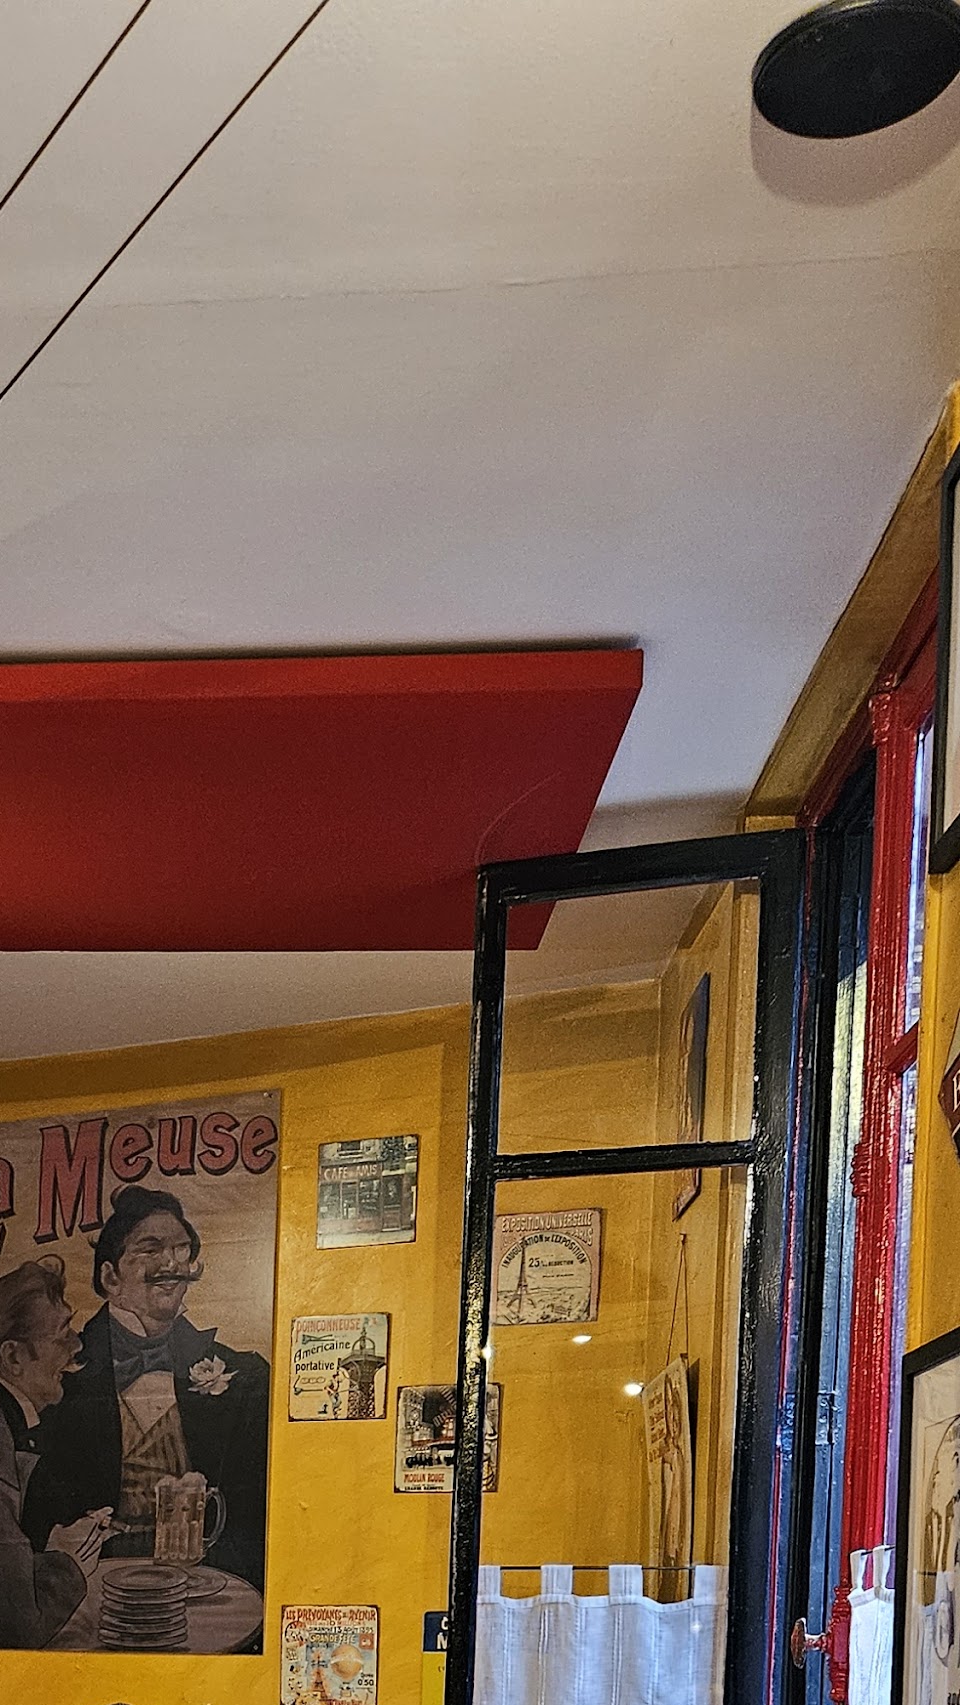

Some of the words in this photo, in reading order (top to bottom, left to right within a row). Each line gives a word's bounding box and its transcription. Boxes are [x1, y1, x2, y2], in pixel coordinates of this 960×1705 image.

[33, 1112, 279, 1245] Meuse
[502, 1216, 545, 1233] EXPOSITION
[546, 1212, 593, 1230] UNIVERSELLE
[294, 1341, 351, 1363] Américaine
[295, 1360, 335, 1375] portative
